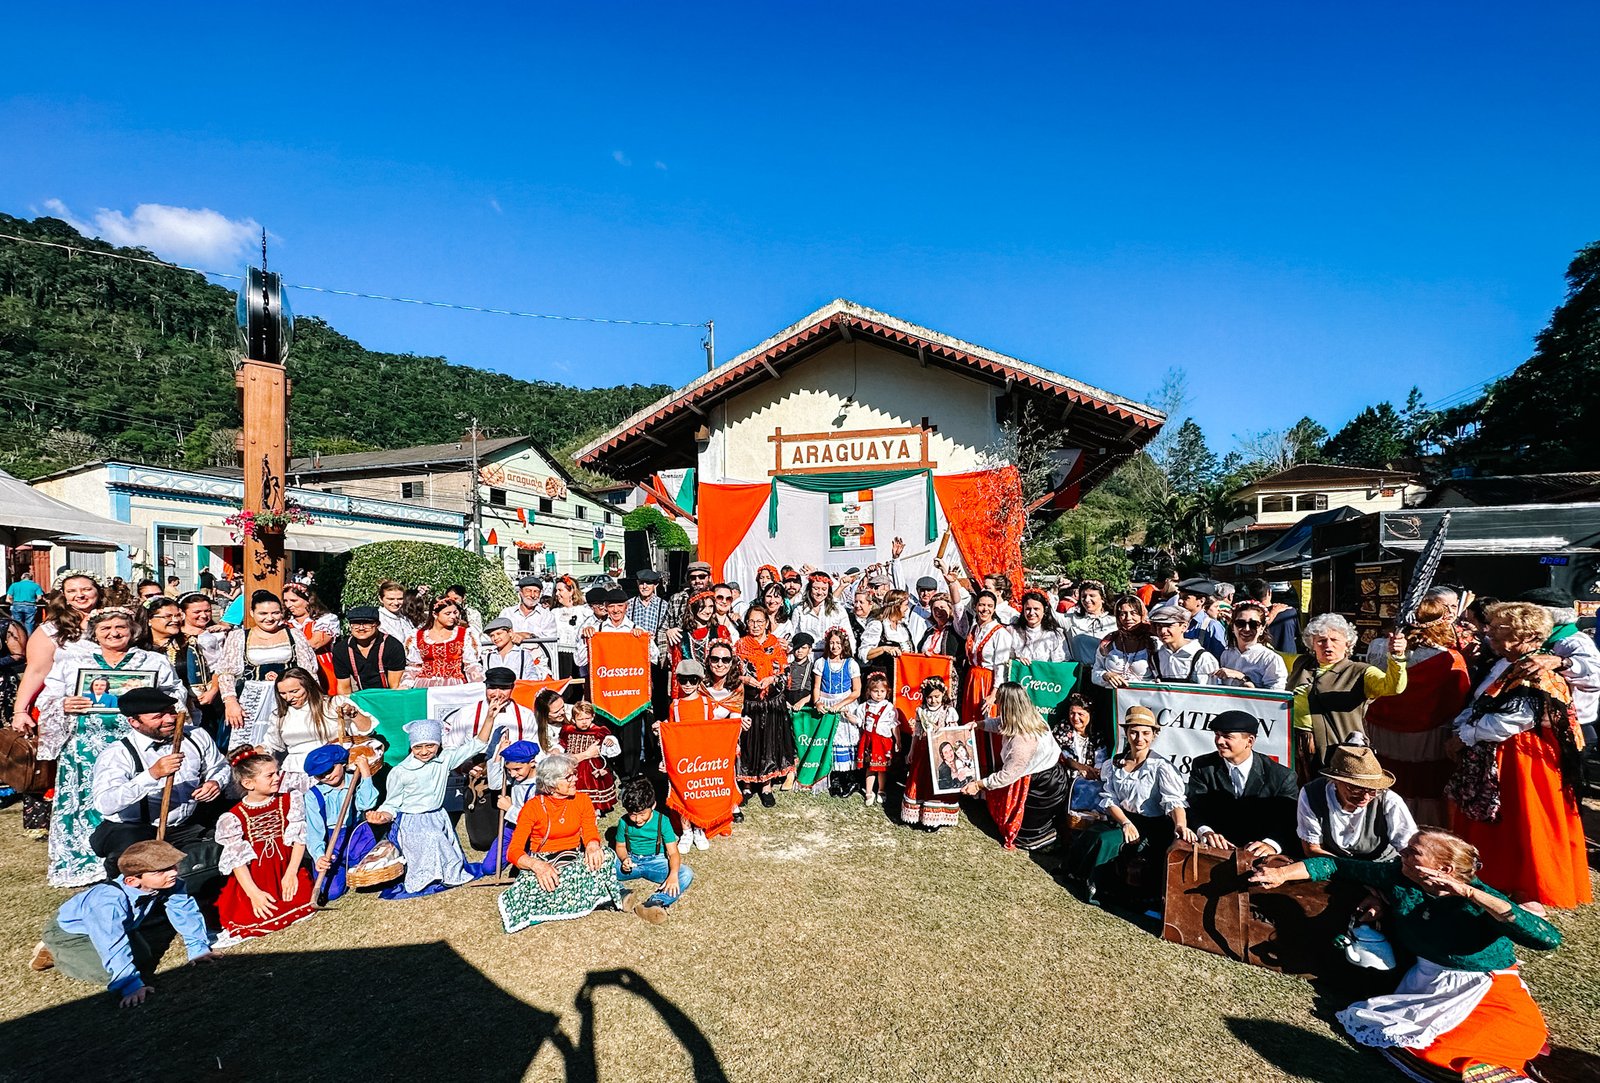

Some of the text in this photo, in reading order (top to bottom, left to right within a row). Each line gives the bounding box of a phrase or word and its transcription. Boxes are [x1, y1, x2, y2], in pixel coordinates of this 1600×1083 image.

[792, 439, 910, 464] ARAGUAYA
[1021, 675, 1062, 693] Grecco
[1157, 708, 1277, 739] CATEN
[677, 756, 729, 774] Celante
